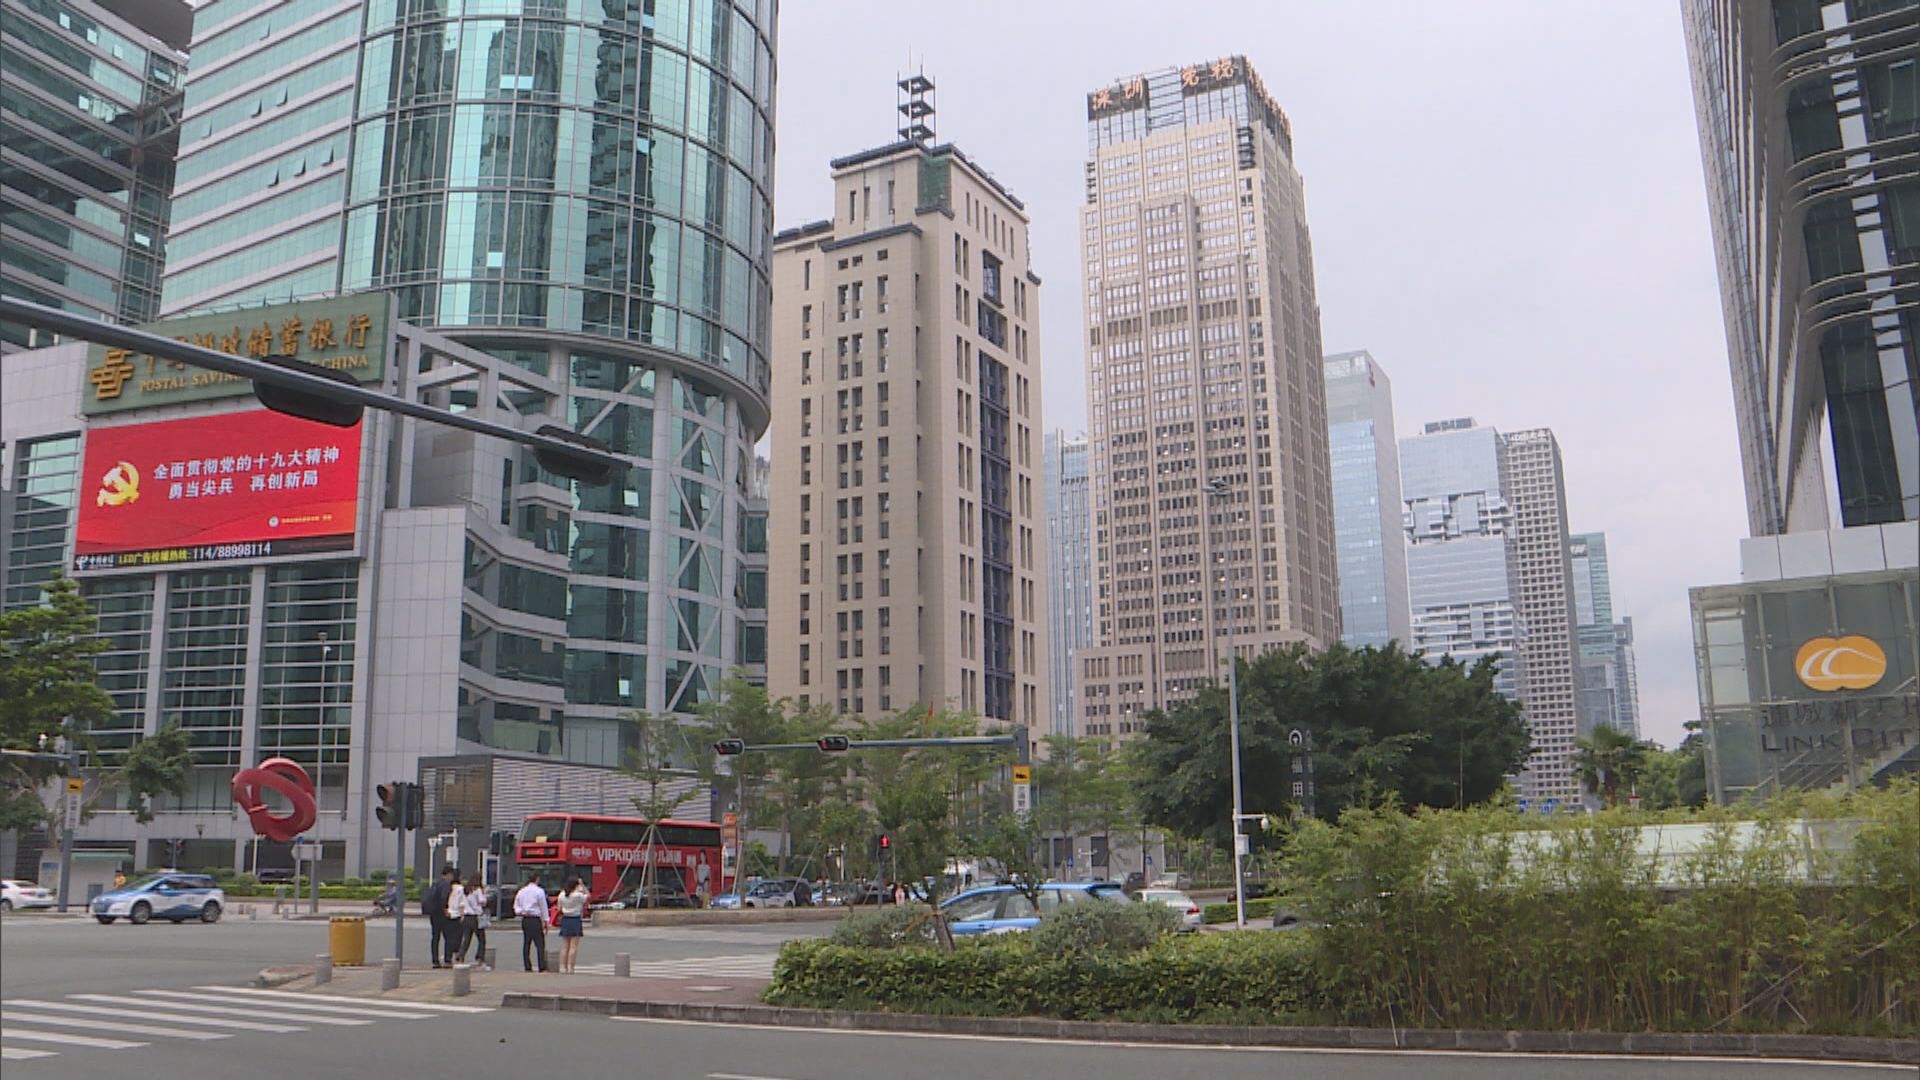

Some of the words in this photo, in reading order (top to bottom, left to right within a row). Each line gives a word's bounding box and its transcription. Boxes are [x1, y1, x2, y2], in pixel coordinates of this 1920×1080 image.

[139, 374, 186, 393] POSTAL
[191, 369, 246, 386] SAVIN
[153, 445, 340, 481] 全面贯彻党的十九大精神
[168, 477, 234, 501] 勇当尖兵
[249, 469, 319, 493] 再创新局
[193, 541, 272, 560] 114/88998114
[1761, 732, 1842, 754] LINK
